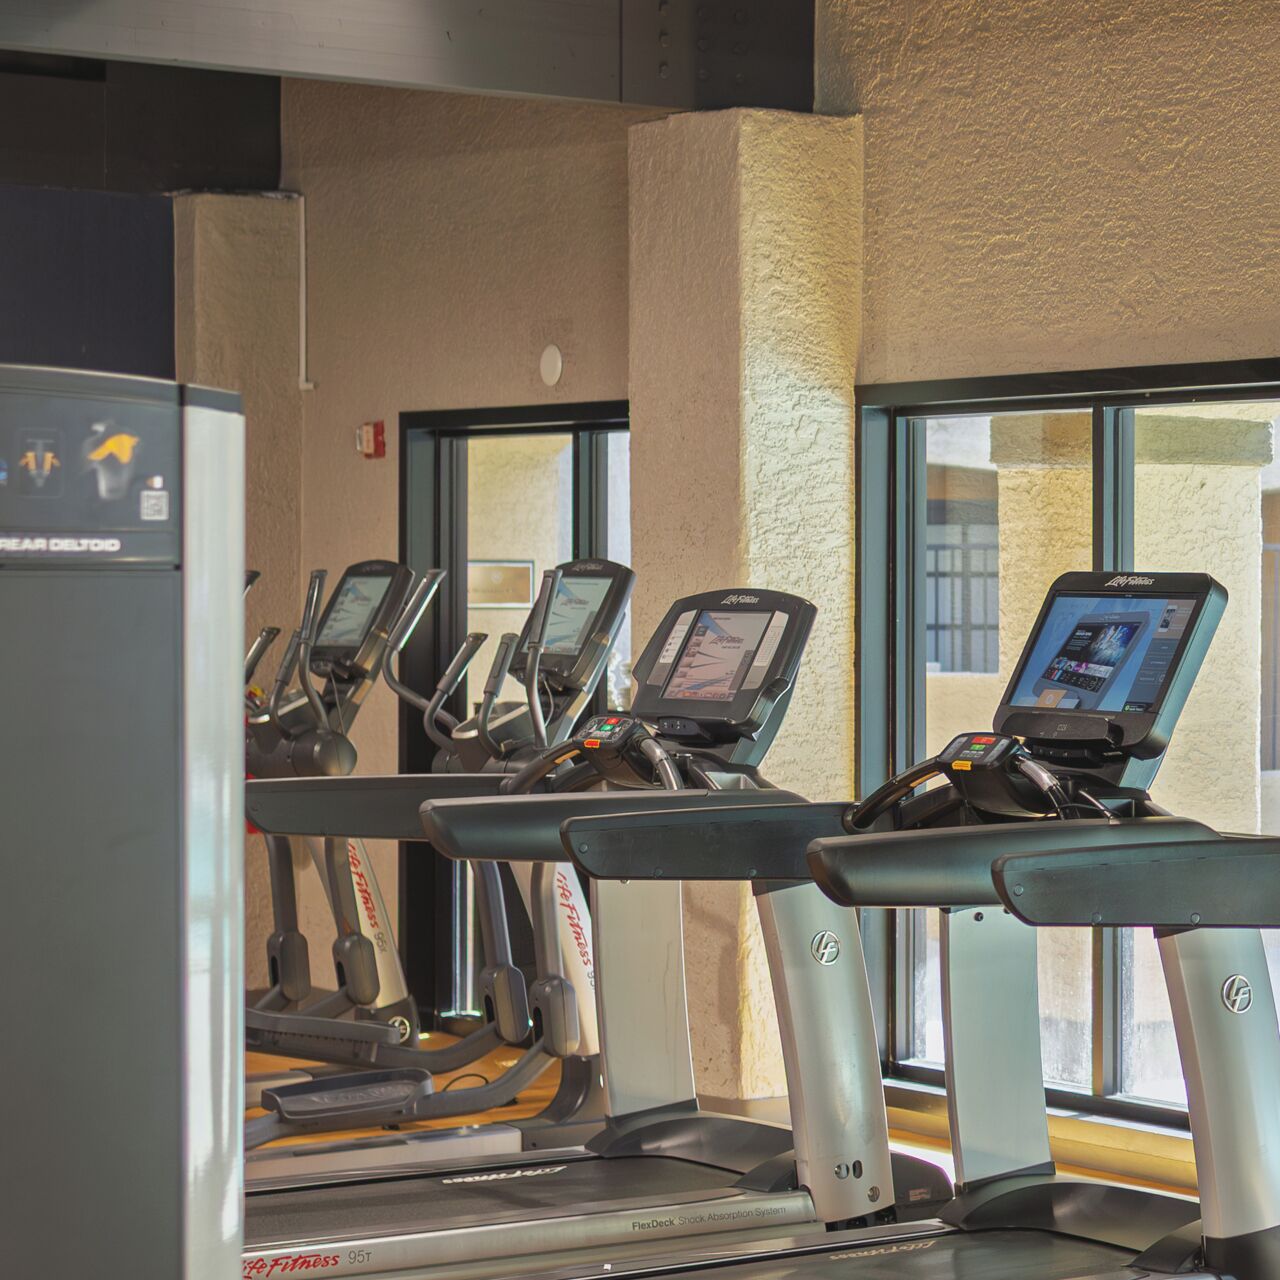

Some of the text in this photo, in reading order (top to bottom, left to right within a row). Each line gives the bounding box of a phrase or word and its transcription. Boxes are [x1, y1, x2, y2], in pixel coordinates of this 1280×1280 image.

[49, 537, 121, 552] DELTOID
[559, 900, 592, 966] Fitness
[632, 1206, 786, 1231] FlexDeck Shock Absorption System
[243, 1254, 340, 1280] ife Fitness
